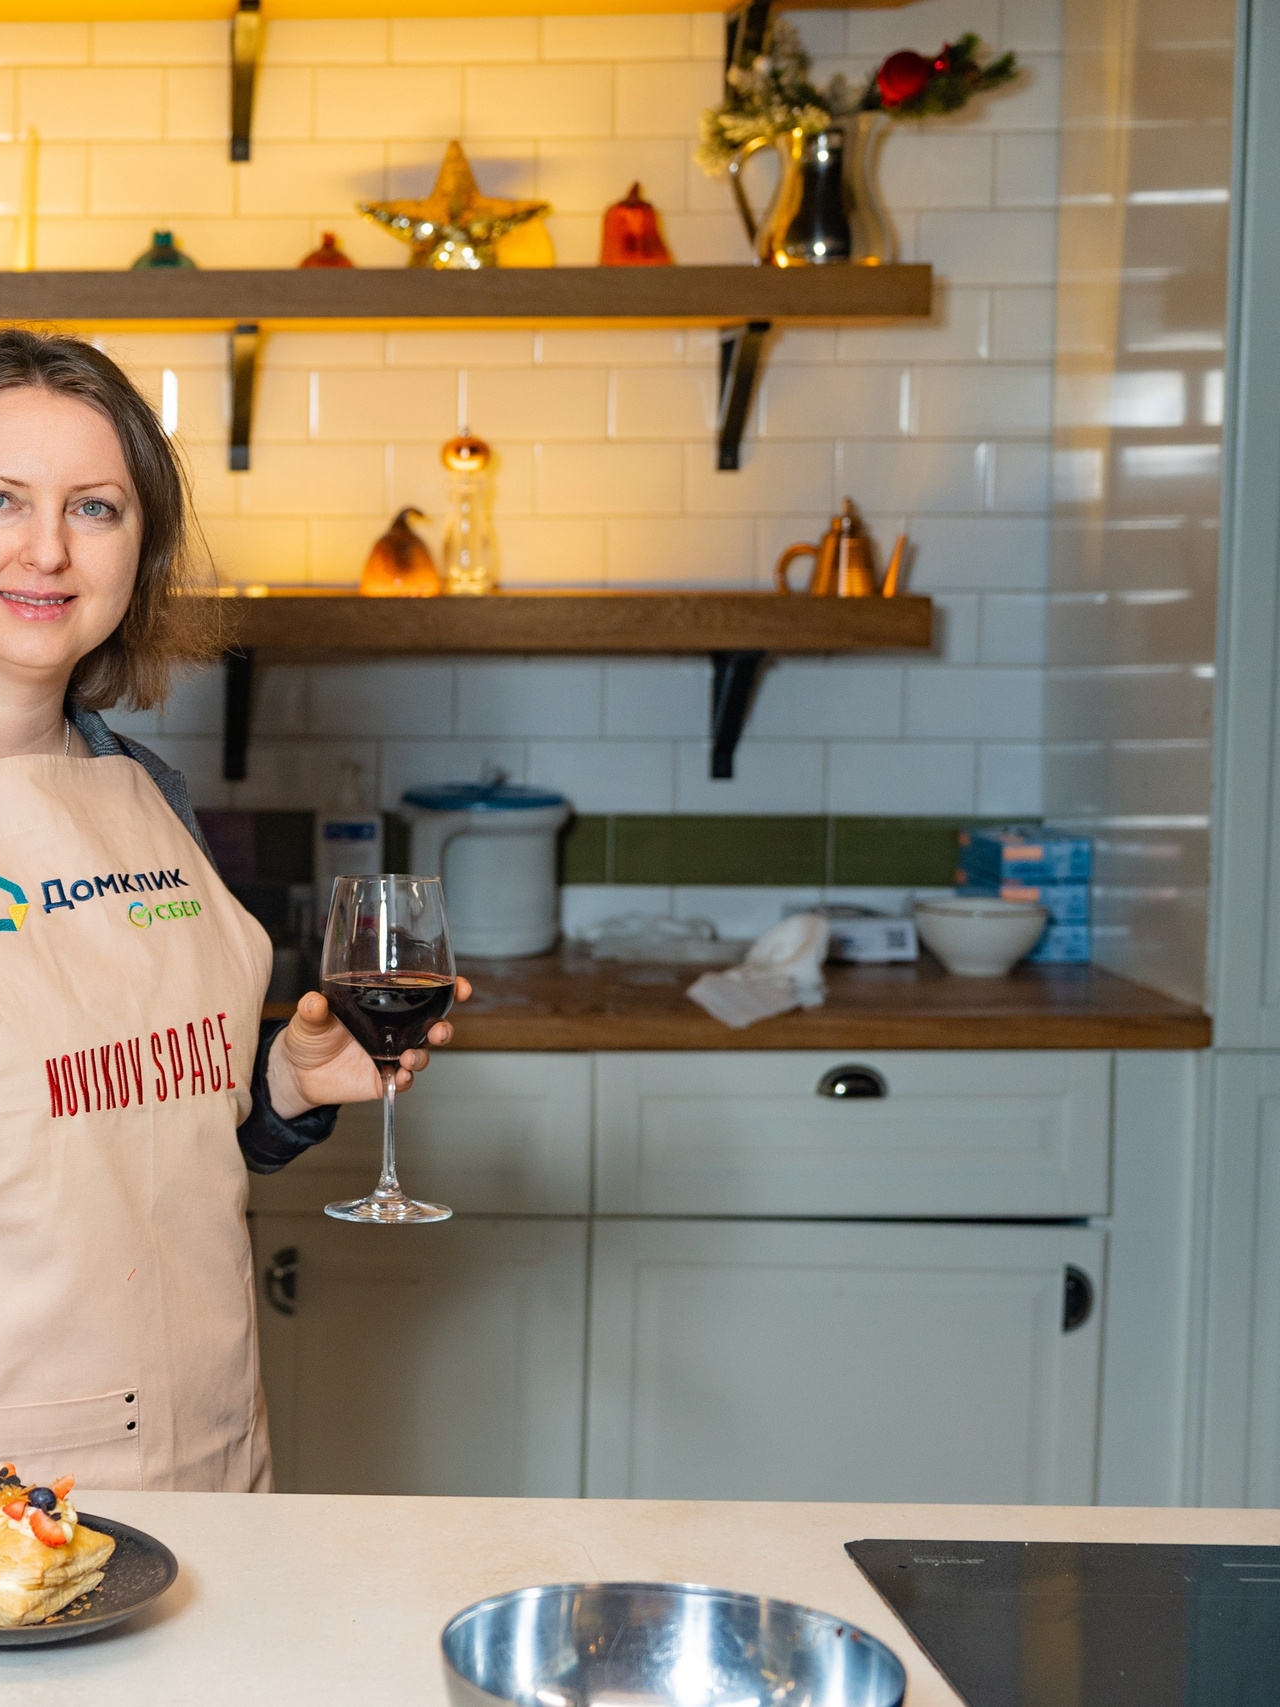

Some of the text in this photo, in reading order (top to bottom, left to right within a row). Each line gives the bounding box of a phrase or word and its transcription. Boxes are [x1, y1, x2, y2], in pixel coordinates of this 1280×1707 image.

[154, 899, 202, 920] СБЕР
[45, 1012, 236, 1118] NOVIKOV SPACE
